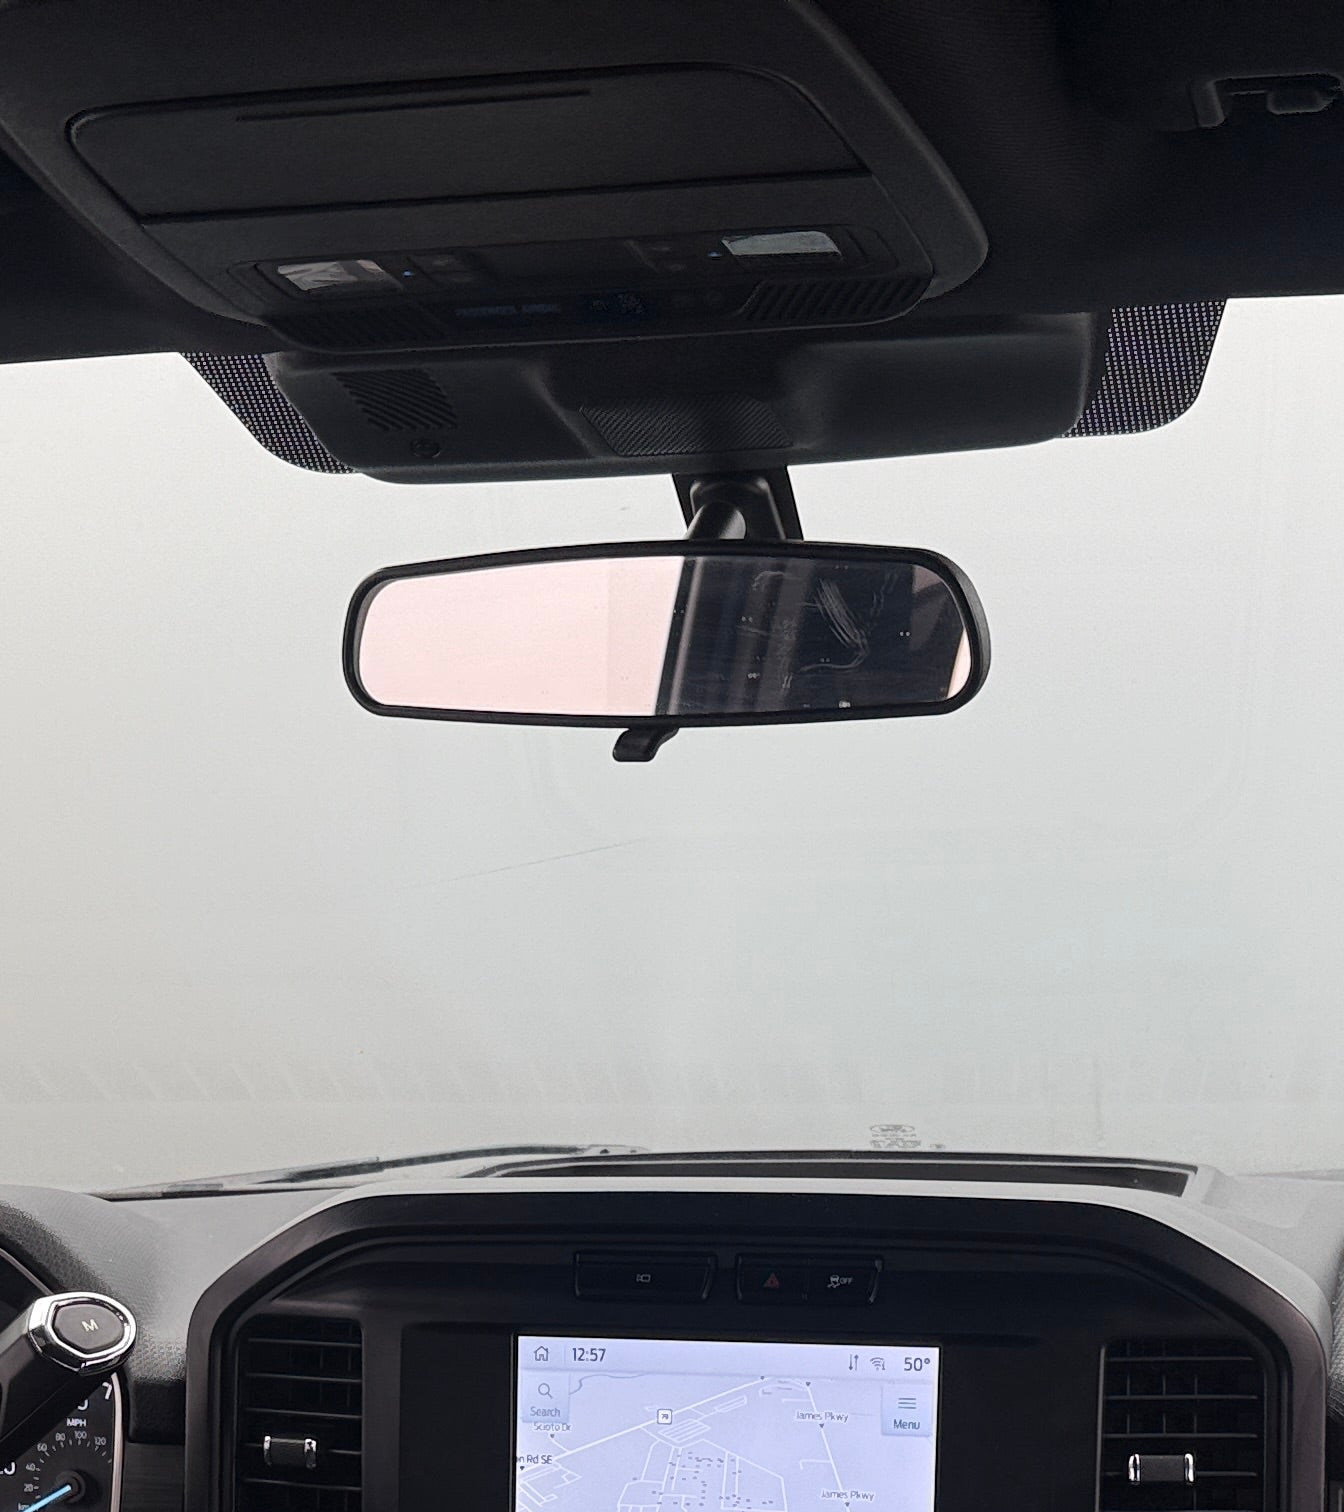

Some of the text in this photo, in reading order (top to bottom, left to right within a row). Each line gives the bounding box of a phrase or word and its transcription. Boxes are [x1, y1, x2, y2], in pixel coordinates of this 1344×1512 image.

[81, 1318, 99, 1332] M
[572, 1347, 607, 1362] 12:57
[904, 1357, 931, 1372] 50°
[530, 1405, 561, 1418] Search
[796, 1411, 849, 1423] James Pkwy
[66, 1418, 86, 1427] MPH
[893, 1418, 921, 1430] Menu
[74, 1431, 87, 1440] 100
[95, 1436, 107, 1446] 120
[526, 1454, 540, 1464] Rd
[540, 1454, 553, 1465] SE
[24, 1483, 34, 1492] 20
[821, 1489, 875, 1501] James Pkwy
